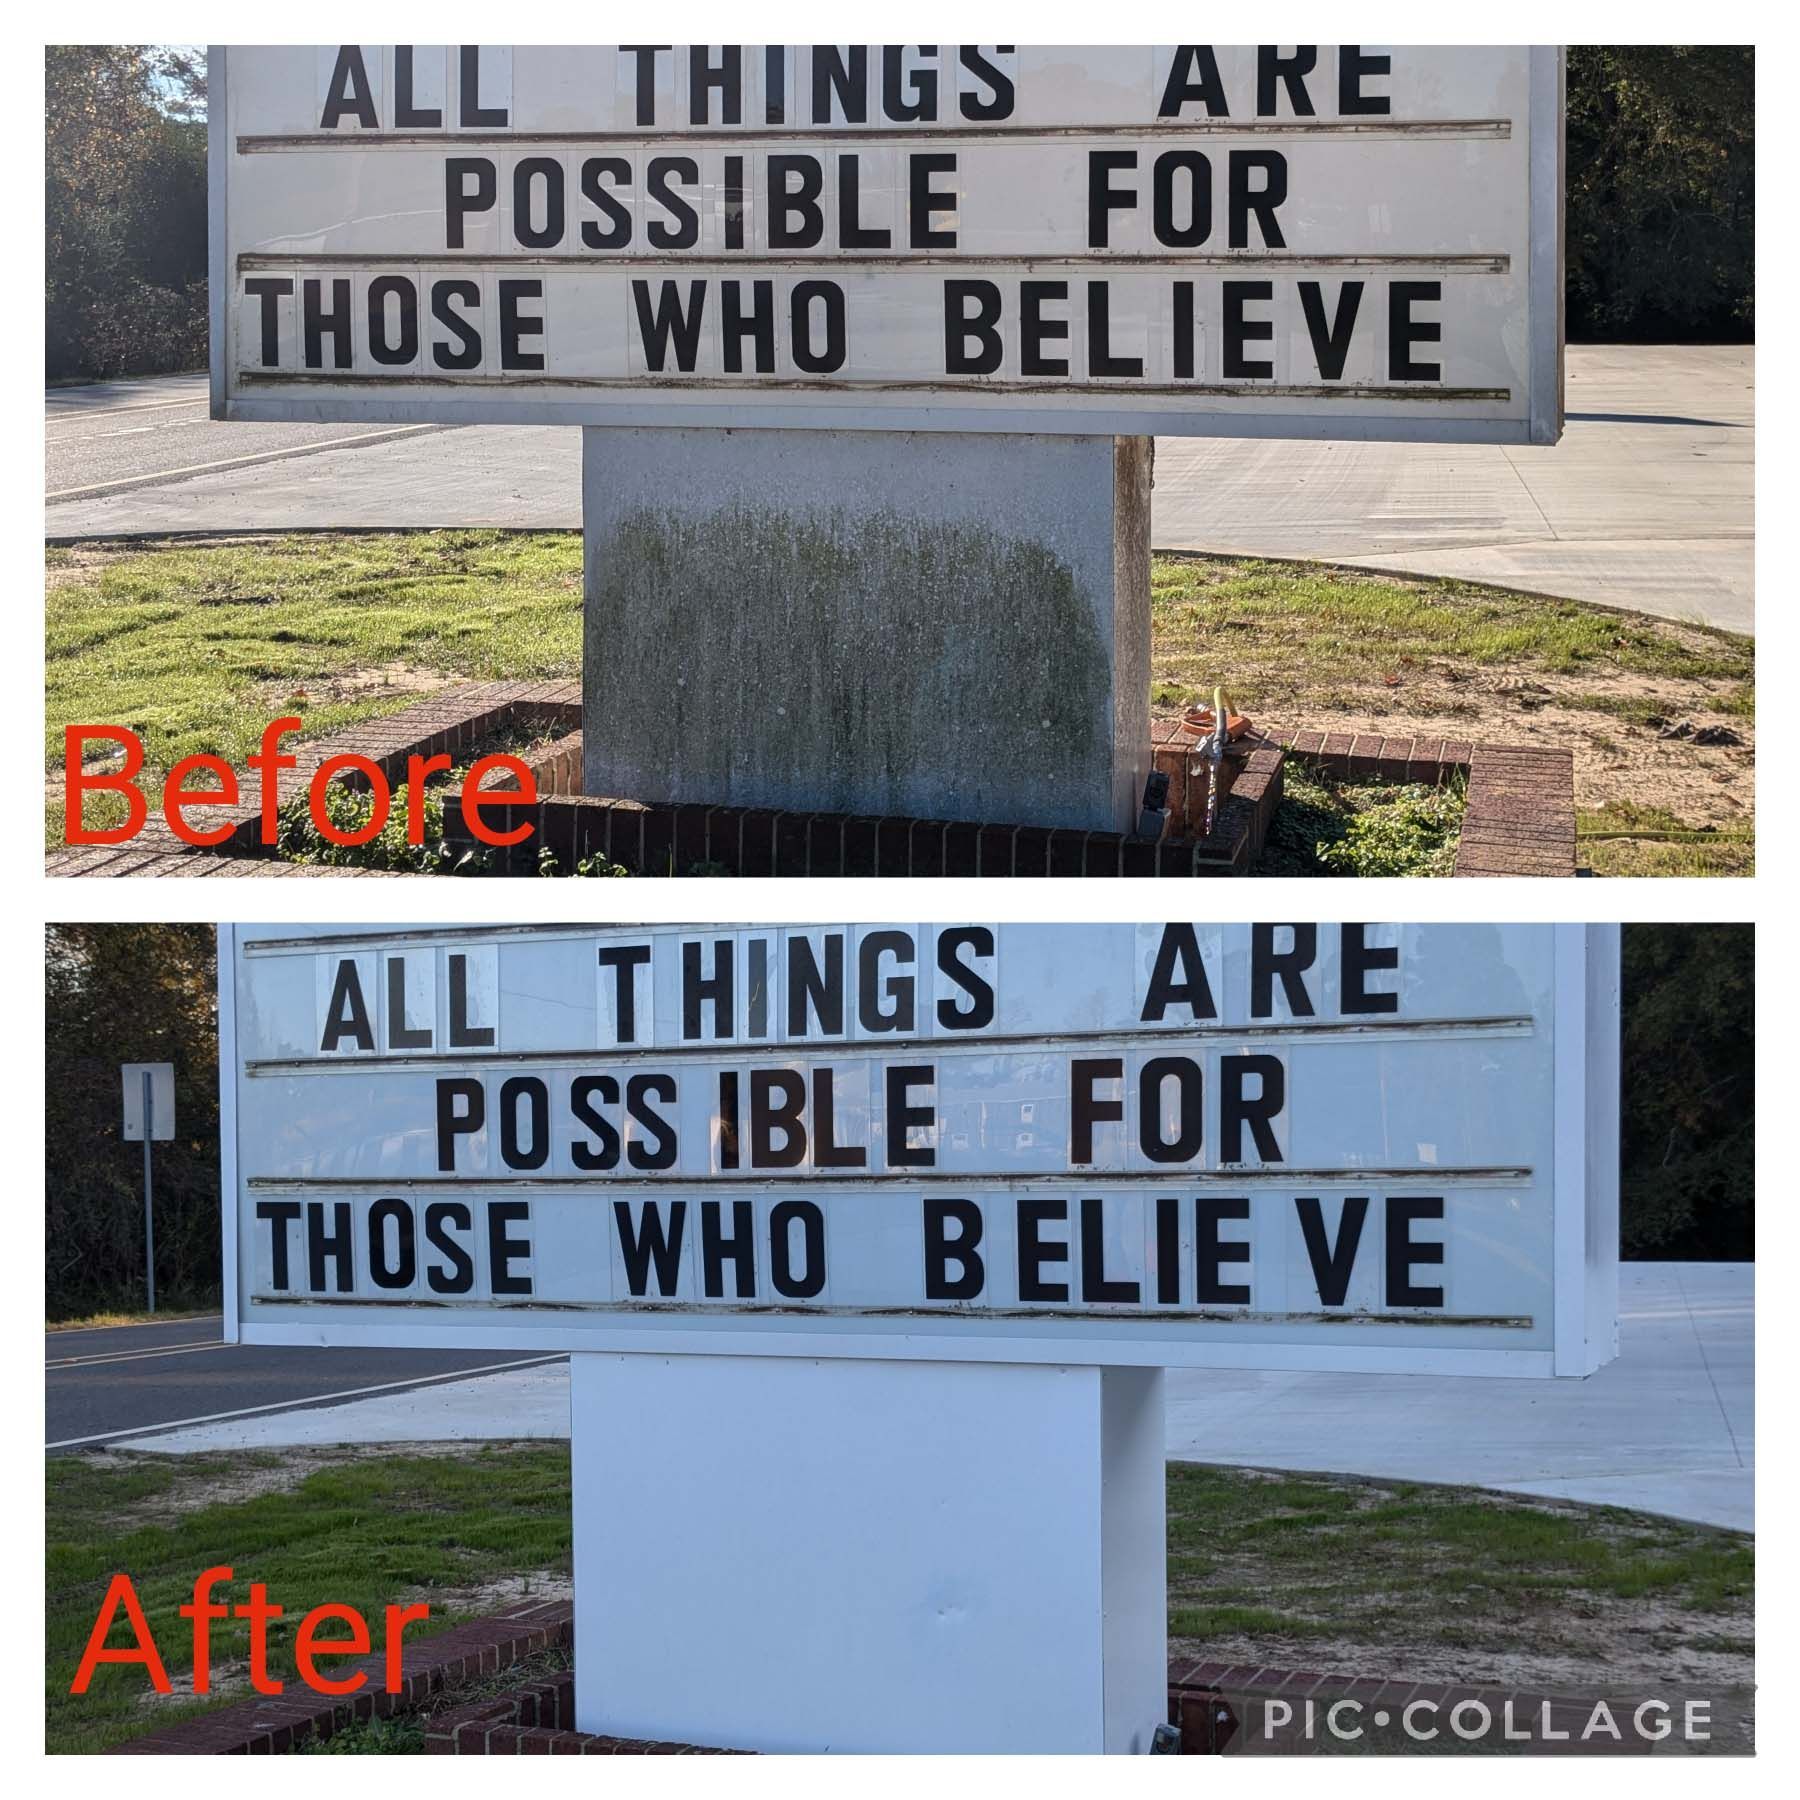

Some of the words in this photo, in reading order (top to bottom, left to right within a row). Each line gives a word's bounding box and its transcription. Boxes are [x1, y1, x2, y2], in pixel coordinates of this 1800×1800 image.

[320, 45, 509, 128] ALL
[619, 45, 1015, 126] THINGS
[1158, 45, 1391, 117] ARE
[446, 154, 957, 249] POSSIBLE
[1088, 150, 1288, 248] FOR
[244, 275, 545, 370] THOSE
[632, 279, 846, 373] WHO
[944, 280, 1441, 381] BELIEVE
[320, 954, 495, 1051] ALL
[599, 926, 994, 1043] THINGS
[1140, 923, 1399, 1020] ARE
[436, 1065, 935, 1171] POSSIBLE
[1071, 1055, 1284, 1164] FOR
[256, 1198, 532, 1294] THOSE
[614, 1200, 825, 1298] WHO
[923, 1197, 1444, 1307] BELIEVE
